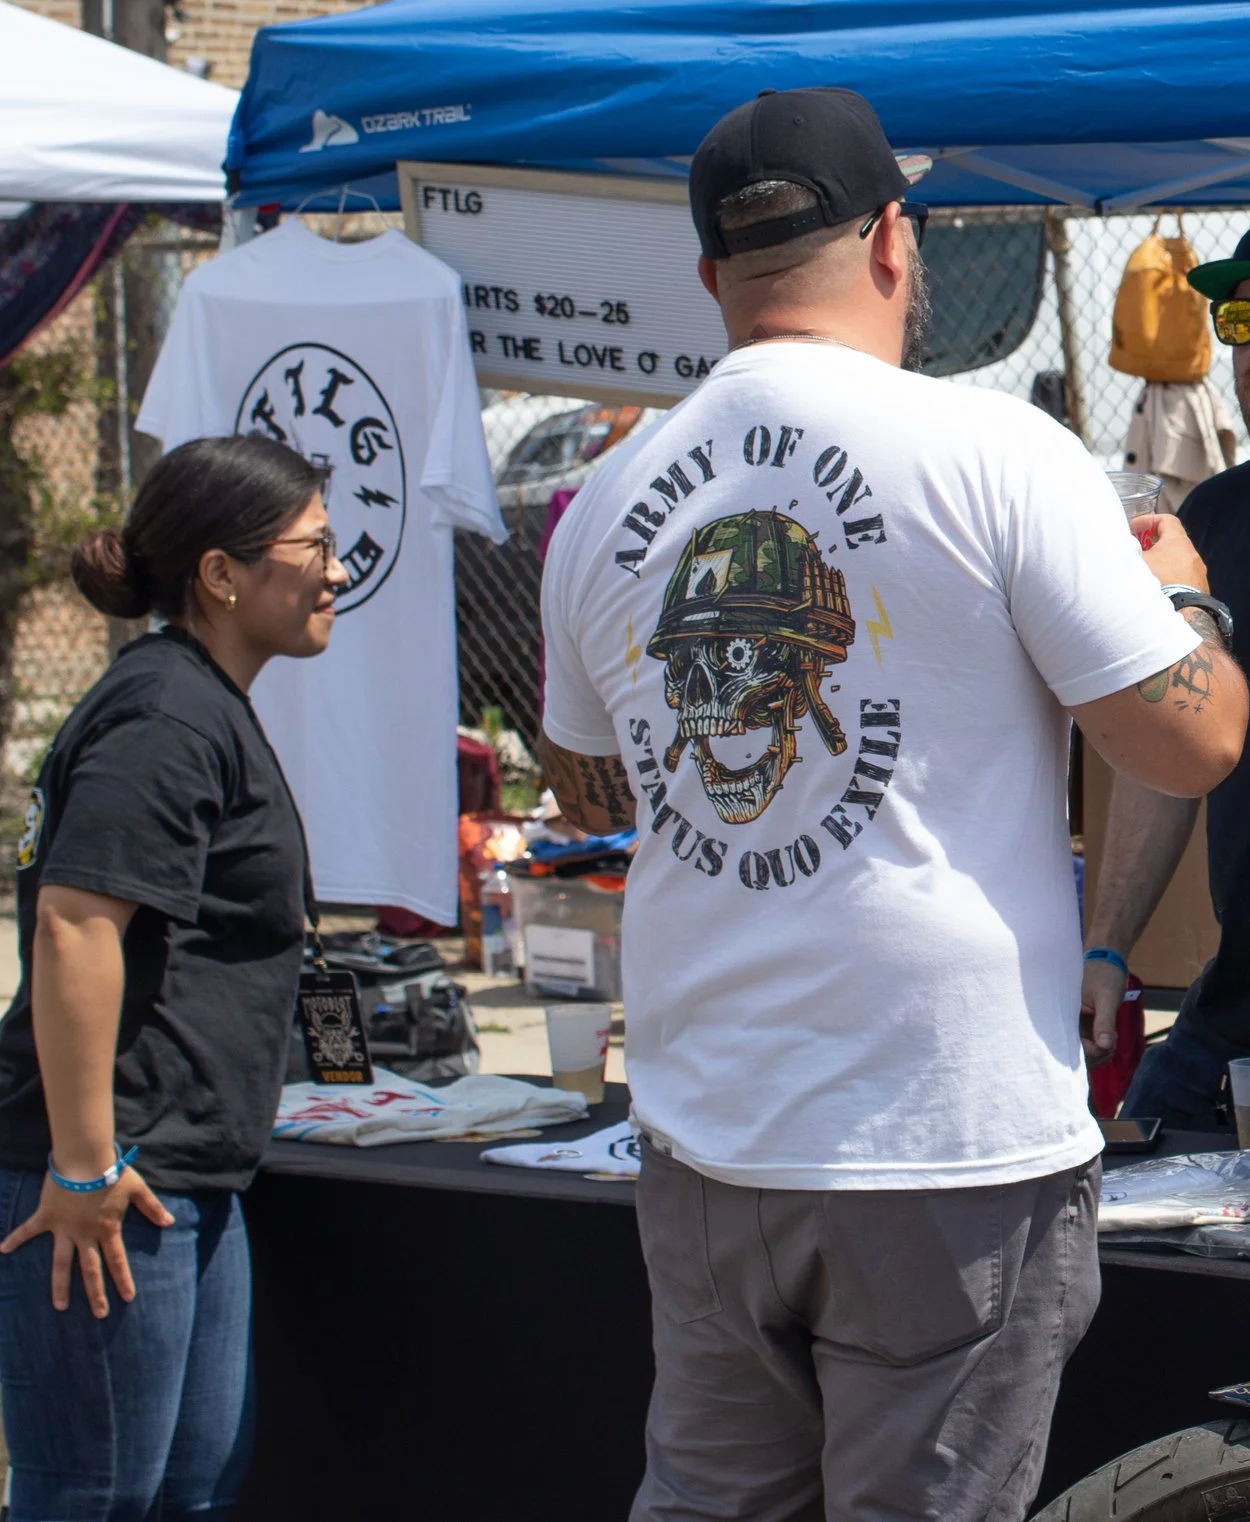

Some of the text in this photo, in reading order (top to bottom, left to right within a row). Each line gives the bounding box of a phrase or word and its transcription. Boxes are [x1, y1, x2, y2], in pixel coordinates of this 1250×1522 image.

[422, 186, 483, 215] FTLG
[464, 283, 519, 312] IRTS
[497, 334, 543, 361] THE
[559, 341, 625, 372] LOVE
[674, 355, 719, 380] GA
[615, 425, 888, 578] ARMY OF ONE
[629, 718, 728, 877] STATUS
[739, 834, 821, 890] QUO
[821, 699, 901, 850] EXILE
